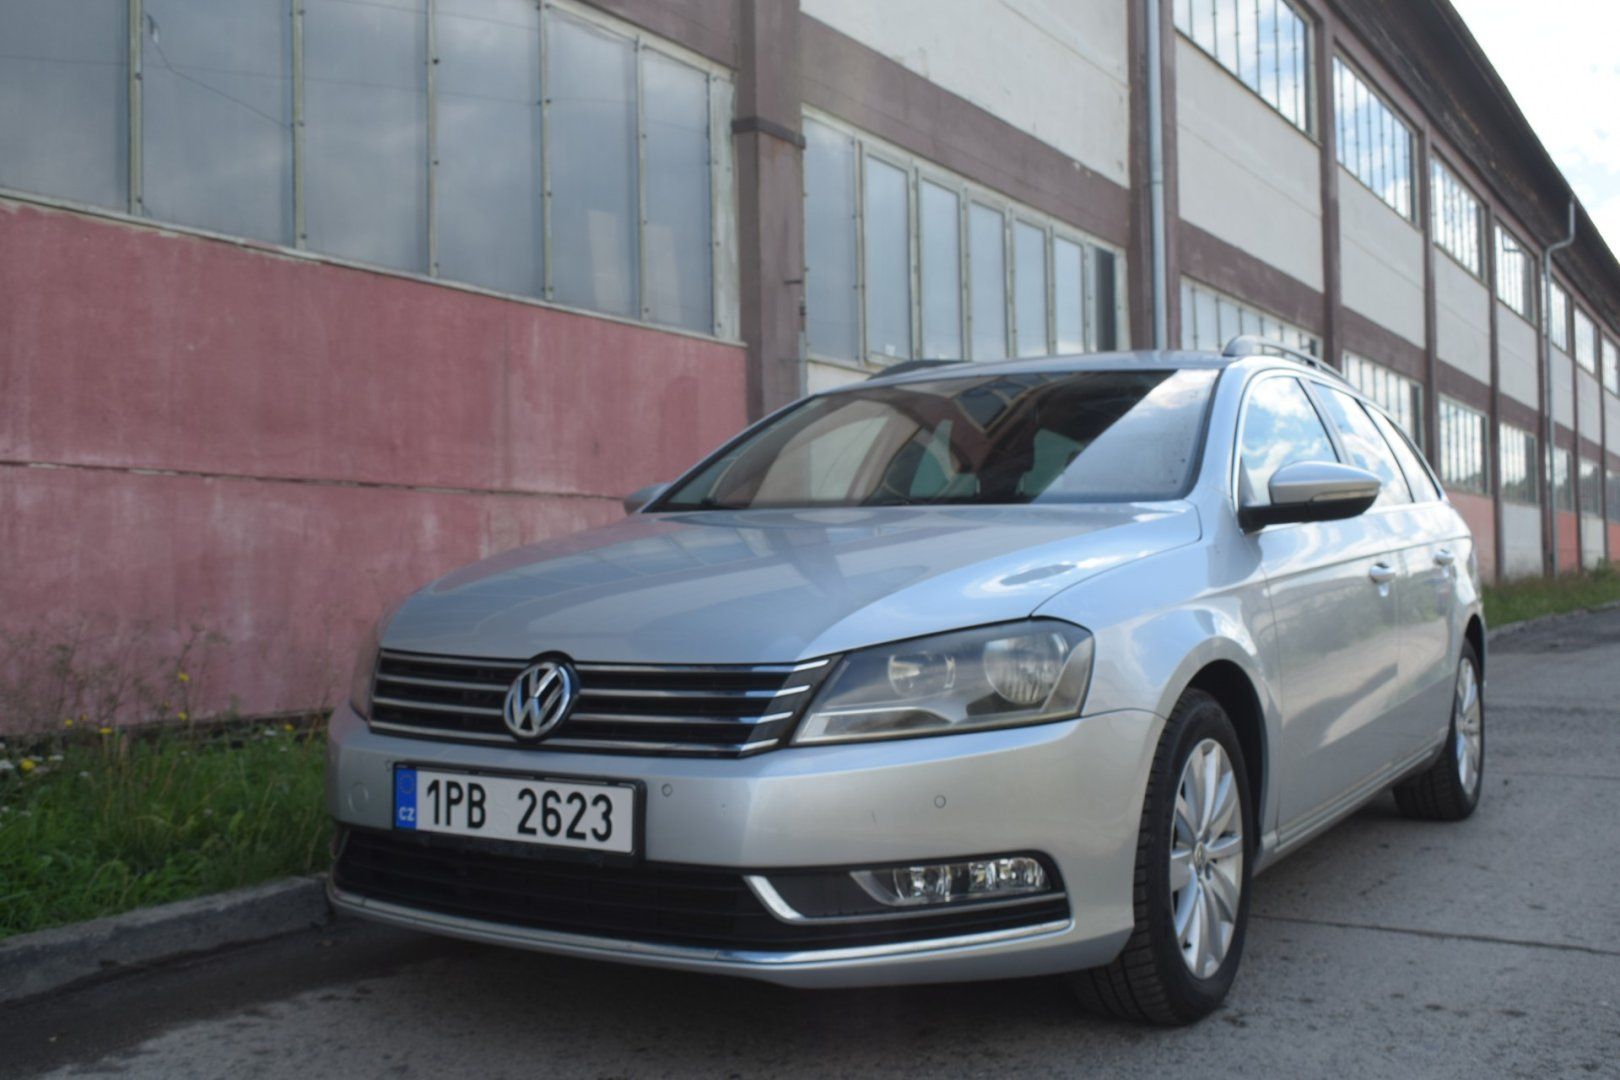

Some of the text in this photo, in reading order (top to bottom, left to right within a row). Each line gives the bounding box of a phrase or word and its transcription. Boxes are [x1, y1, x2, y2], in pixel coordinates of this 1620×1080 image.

[505, 662, 570, 736] VW
[399, 806, 415, 821] CZ
[427, 779, 613, 842] 1PB 2623
